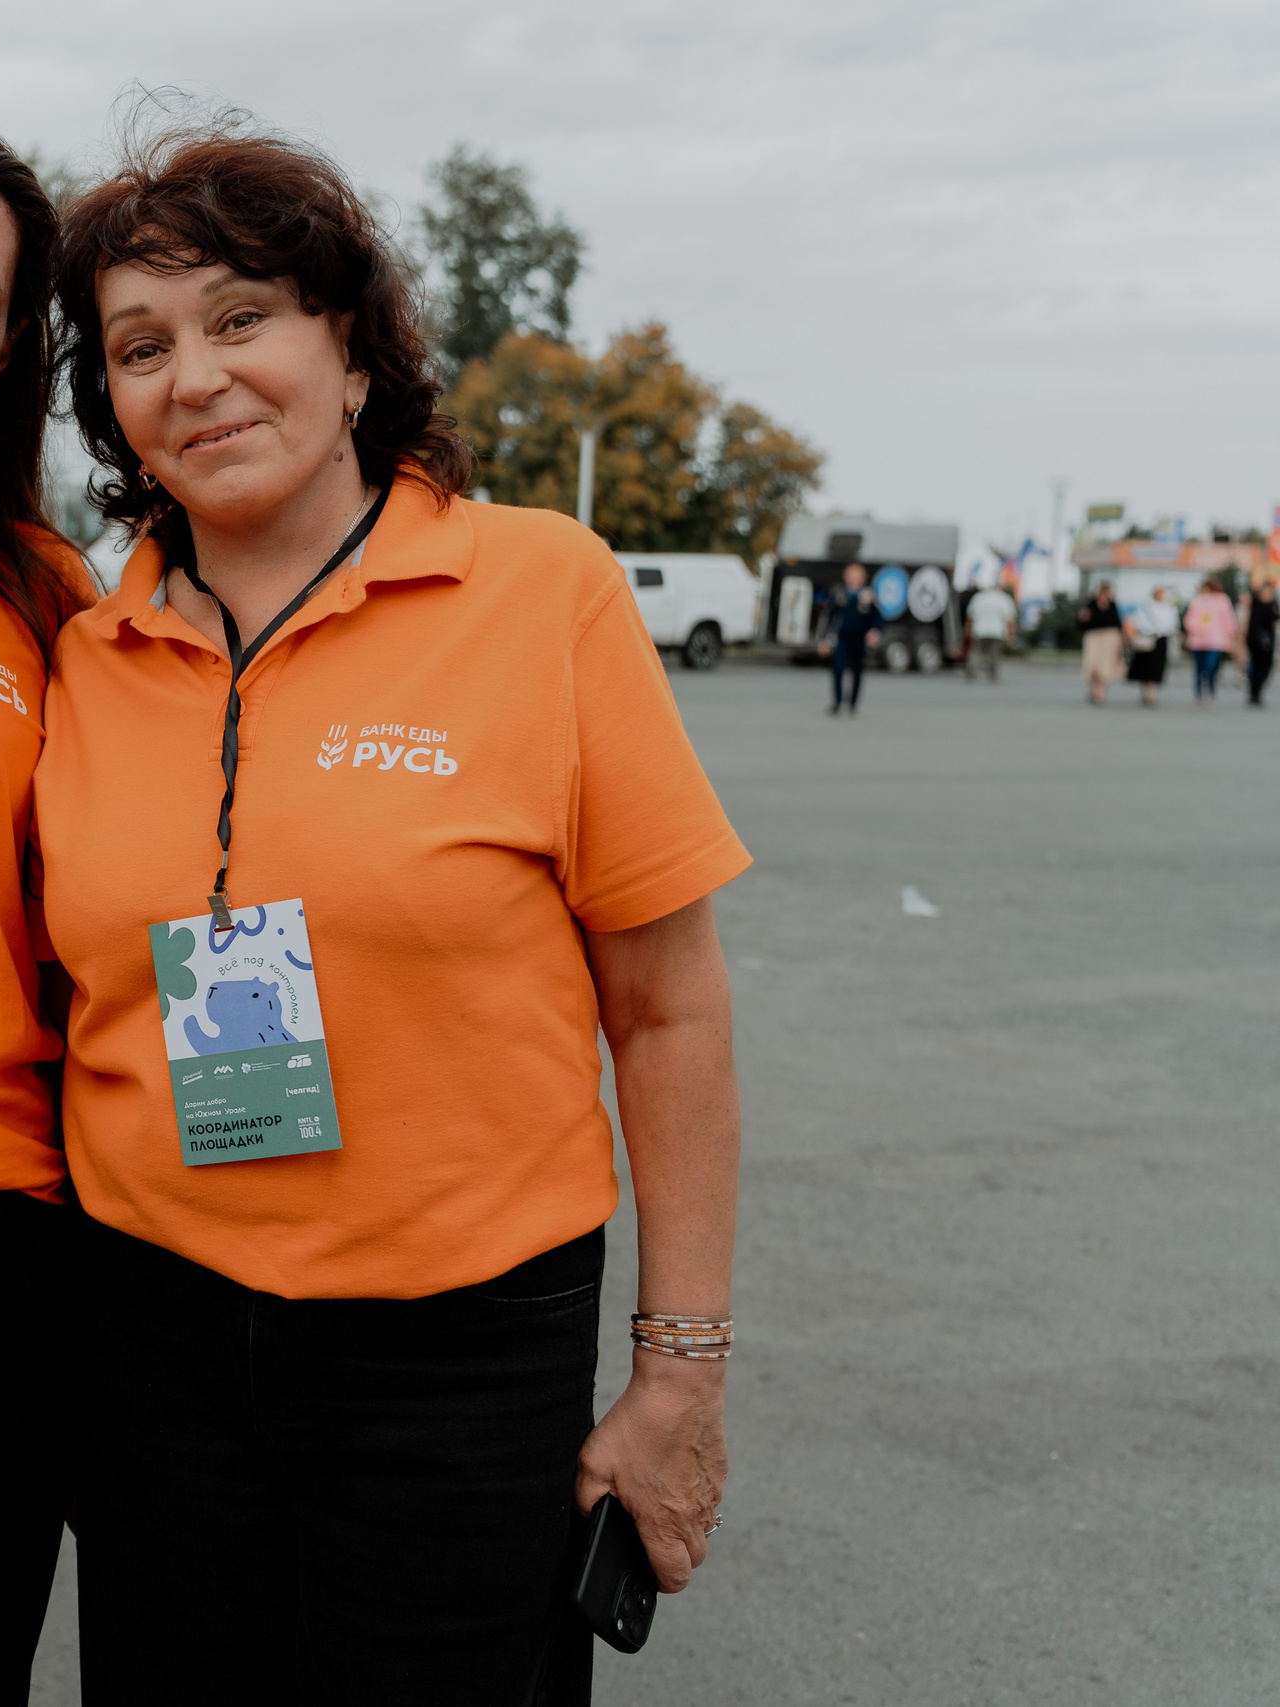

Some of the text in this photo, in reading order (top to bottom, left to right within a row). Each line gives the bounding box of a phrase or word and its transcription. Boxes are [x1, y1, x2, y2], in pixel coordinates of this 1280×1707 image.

[360, 724, 447, 743] БАНК ЕДЫ
[352, 742, 458, 776] РУСЬ
[218, 957, 299, 1025] Всё под контролем
[184, 1098, 226, 1109] Дарим добро
[195, 1110, 222, 1118] Южном
[224, 1106, 246, 1115] Урале
[188, 1115, 282, 1136] КООРДИНАТОР
[299, 1126, 322, 1139] 100.4
[190, 1134, 264, 1152] ПЛОЩАДКИ
